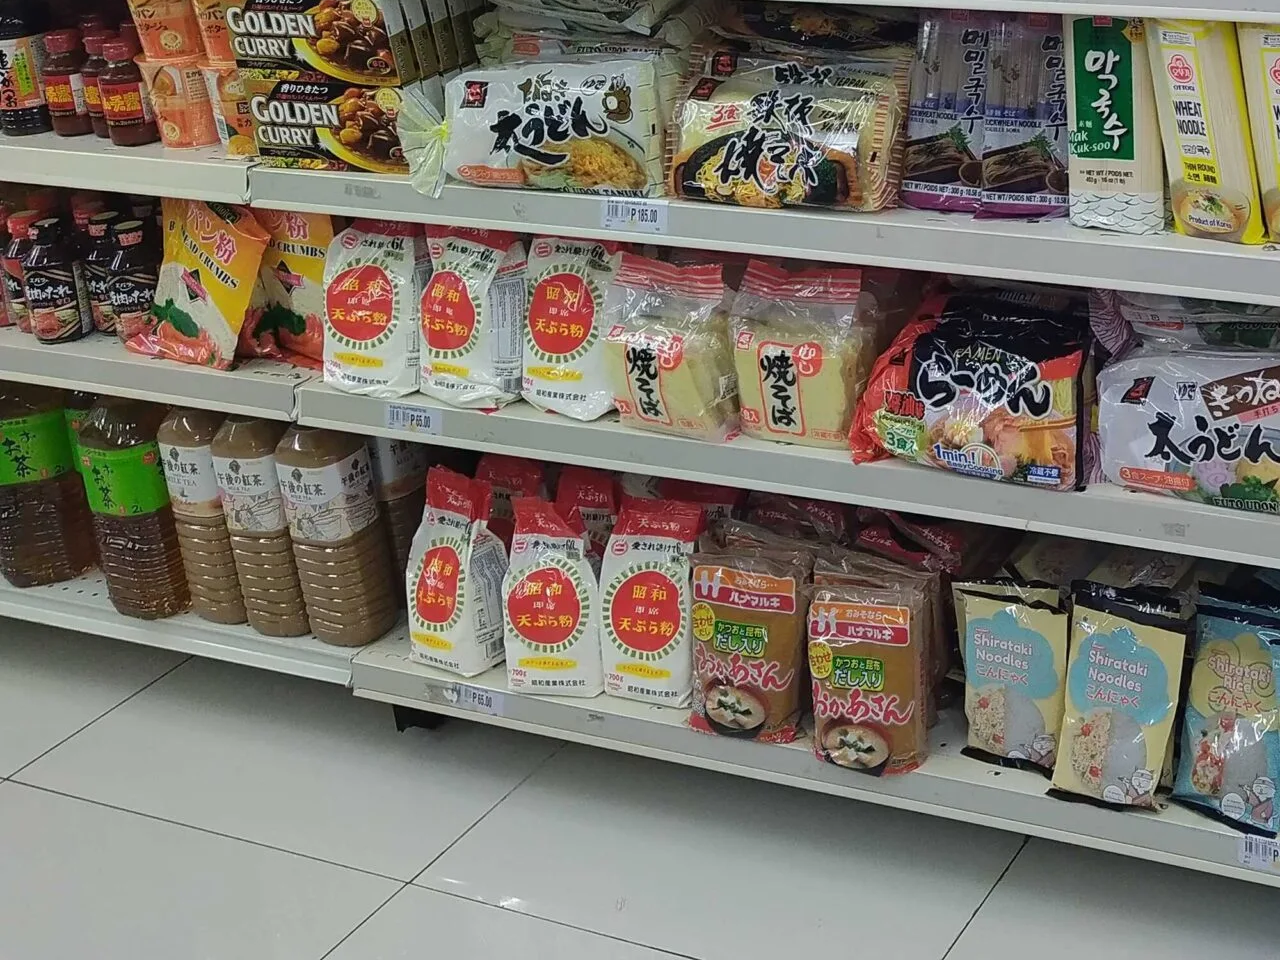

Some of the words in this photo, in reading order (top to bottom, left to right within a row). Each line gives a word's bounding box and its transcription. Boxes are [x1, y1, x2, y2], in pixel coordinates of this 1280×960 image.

[226, 7, 317, 37] GOLDEN
[234, 36, 293, 57] CURRY
[1173, 84, 1195, 92] OTTOGI
[251, 99, 341, 127] GOLDEN
[1173, 99, 1203, 119] WHEAT
[257, 126, 315, 146] CURRY
[1176, 118, 1207, 138] NOODLE
[1071, 141, 1110, 153] Kuk-soo
[1184, 161, 1197, 172] THIN
[1198, 164, 1216, 175] ROUND
[1188, 213, 1209, 227] Product
[1210, 219, 1216, 227] of
[1217, 219, 1233, 230] Korea
[199, 250, 239, 290] CRUMBS
[1245, 501, 1279, 512] UDON
[618, 617, 675, 637] 天ぷら粉
[974, 634, 1034, 655] Shirataki
[975, 651, 1029, 671] Noodles
[1087, 650, 1148, 677] Shirataki
[1207, 656, 1272, 686] Shirataki
[1088, 668, 1142, 692] Noodles
[1223, 674, 1252, 694] Rice
